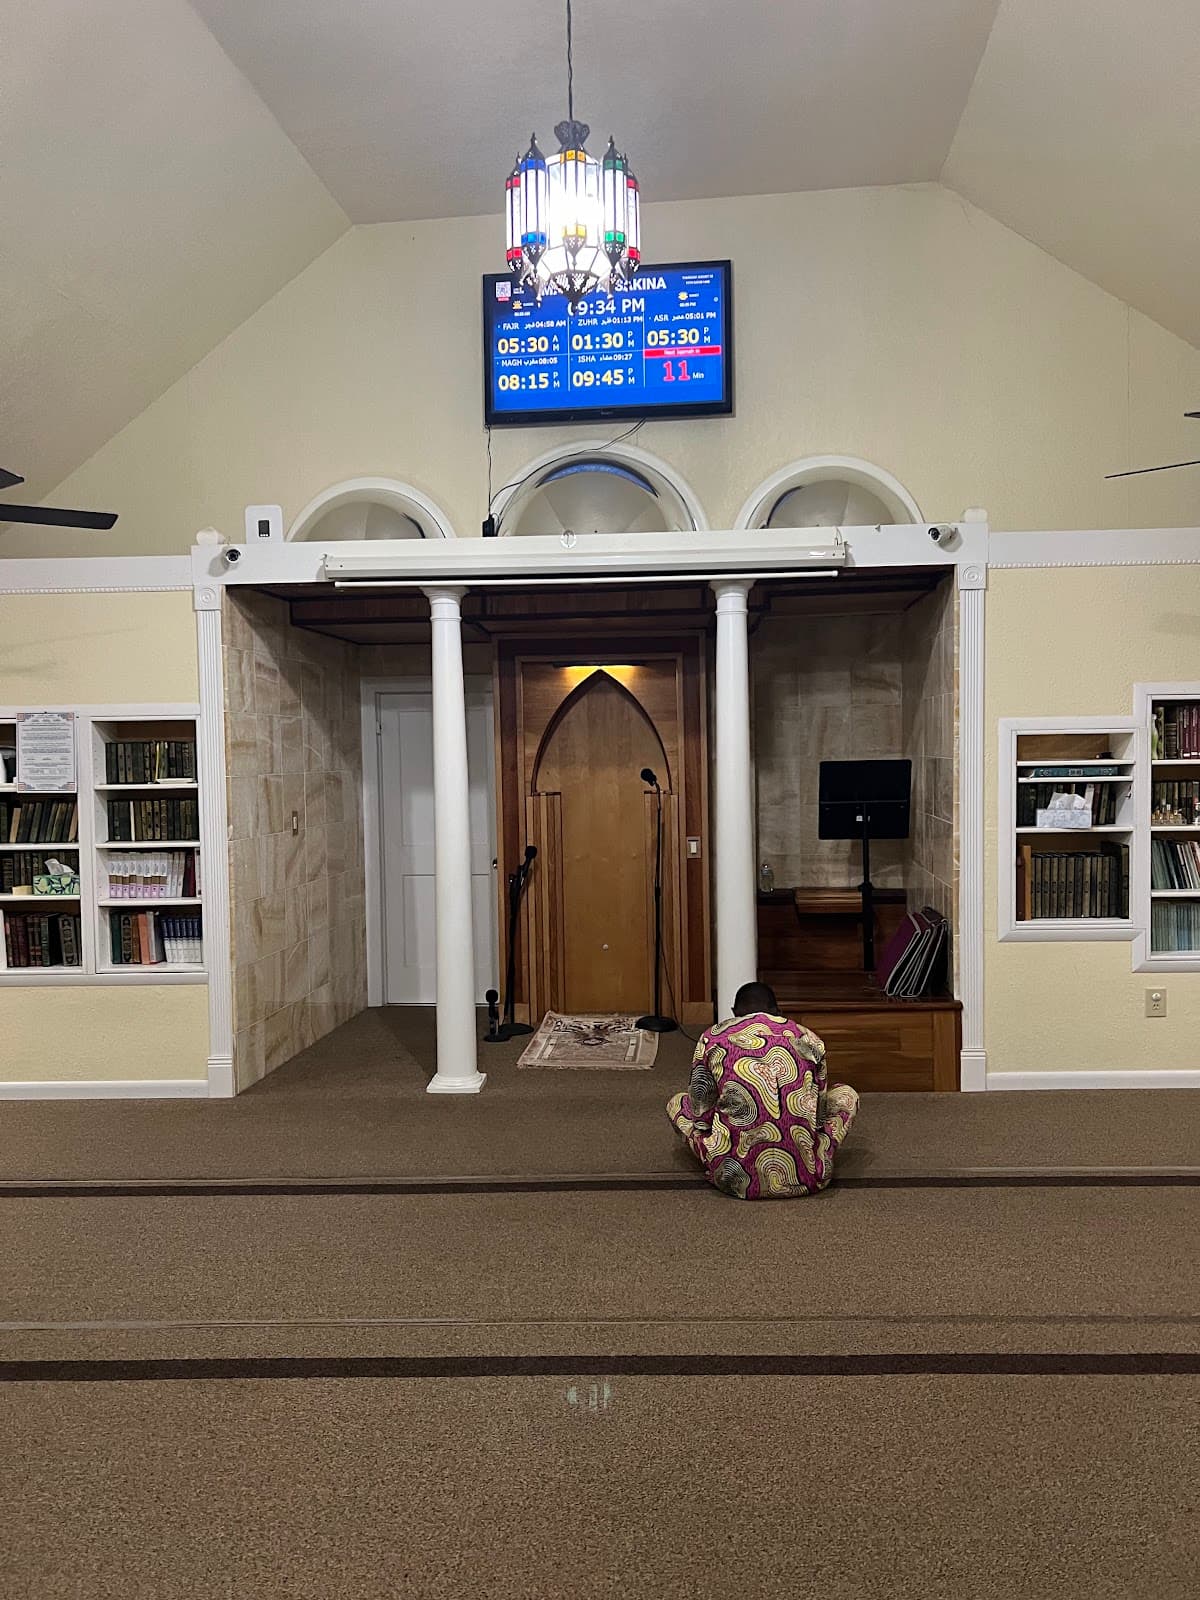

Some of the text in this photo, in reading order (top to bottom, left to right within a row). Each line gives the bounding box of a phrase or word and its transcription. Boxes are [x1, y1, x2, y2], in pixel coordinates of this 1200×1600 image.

[622, 298, 645, 313] PM
[503, 322, 520, 330] FAJR
[556, 319, 567, 327] AM
[578, 318, 598, 326] ZUHR
[633, 315, 643, 323] PM
[654, 314, 669, 323] ASR
[685, 312, 705, 320] 05:01
[497, 336, 549, 354] 05:30
[571, 332, 624, 350] 01:30
[647, 328, 699, 346] 05:30
[501, 359, 522, 367] MAGH
[578, 355, 596, 363] ISHA
[572, 369, 624, 388] 09:45
[663, 360, 705, 382] 11 Min
[498, 373, 549, 391] 08:15
